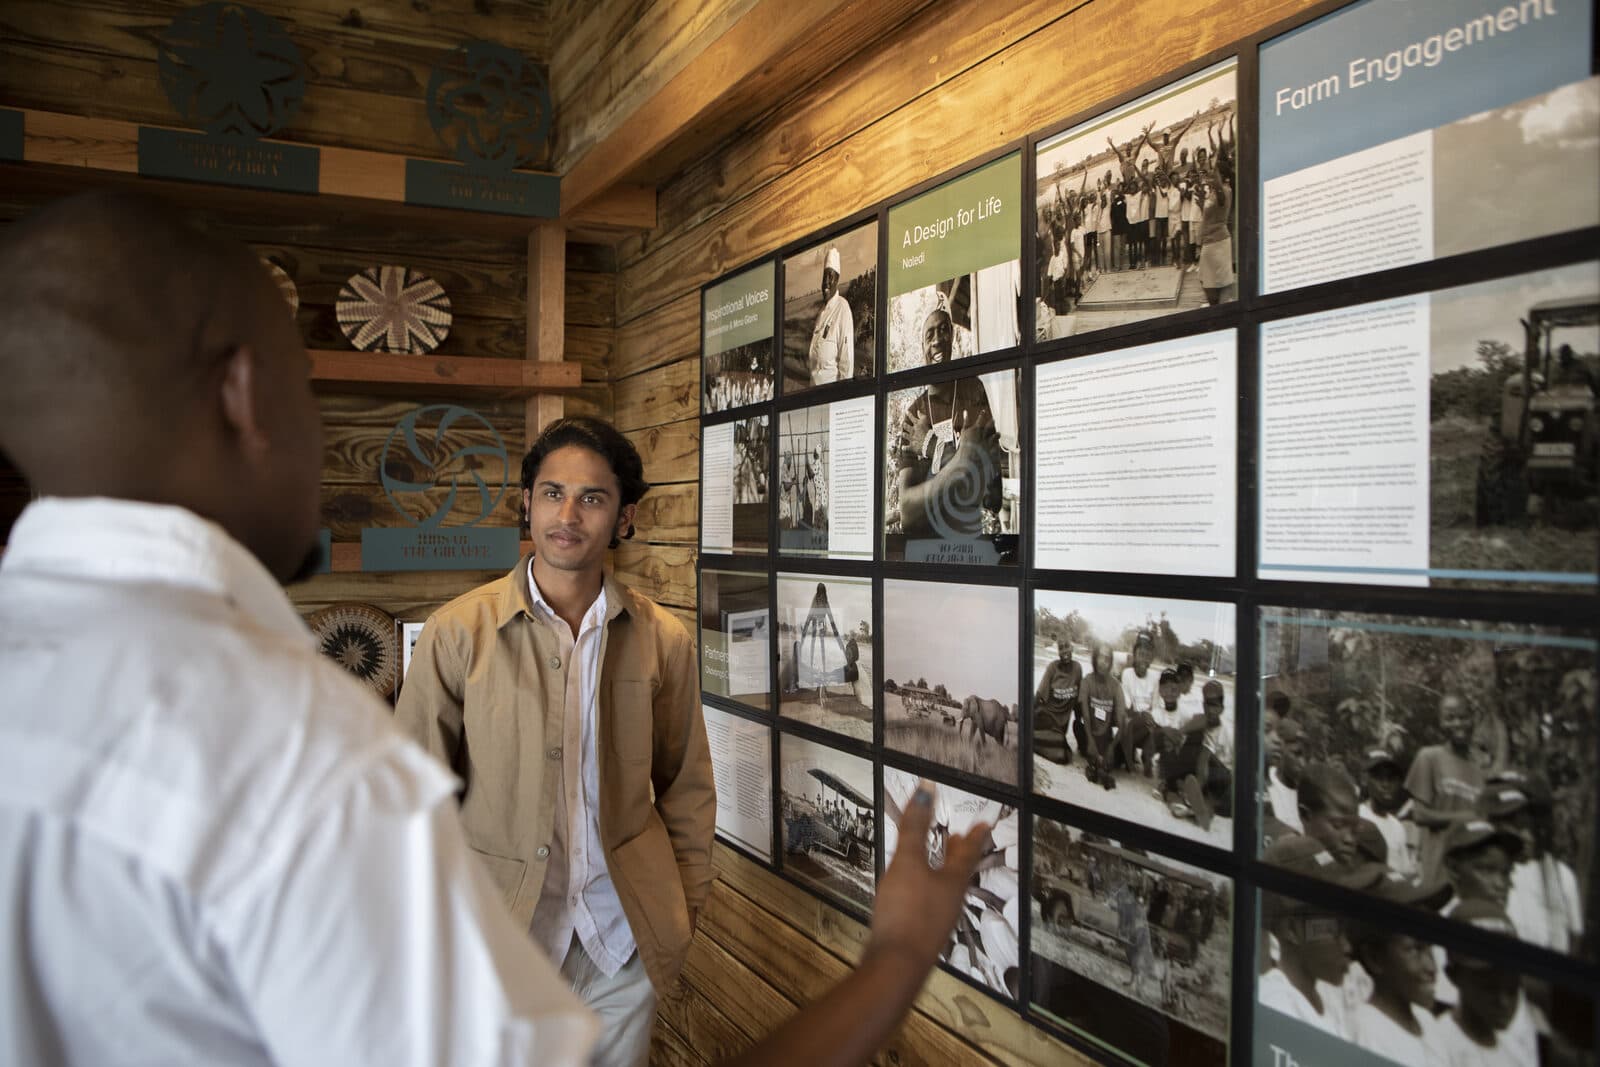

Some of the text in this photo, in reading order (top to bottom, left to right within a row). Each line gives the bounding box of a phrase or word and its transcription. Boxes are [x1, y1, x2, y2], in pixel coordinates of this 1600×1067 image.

[1275, 0, 1557, 117] Farm Engagement
[902, 196, 1002, 249] A Design for Life
[902, 252, 925, 270] Naledi
[746, 288, 769, 308] Voices
